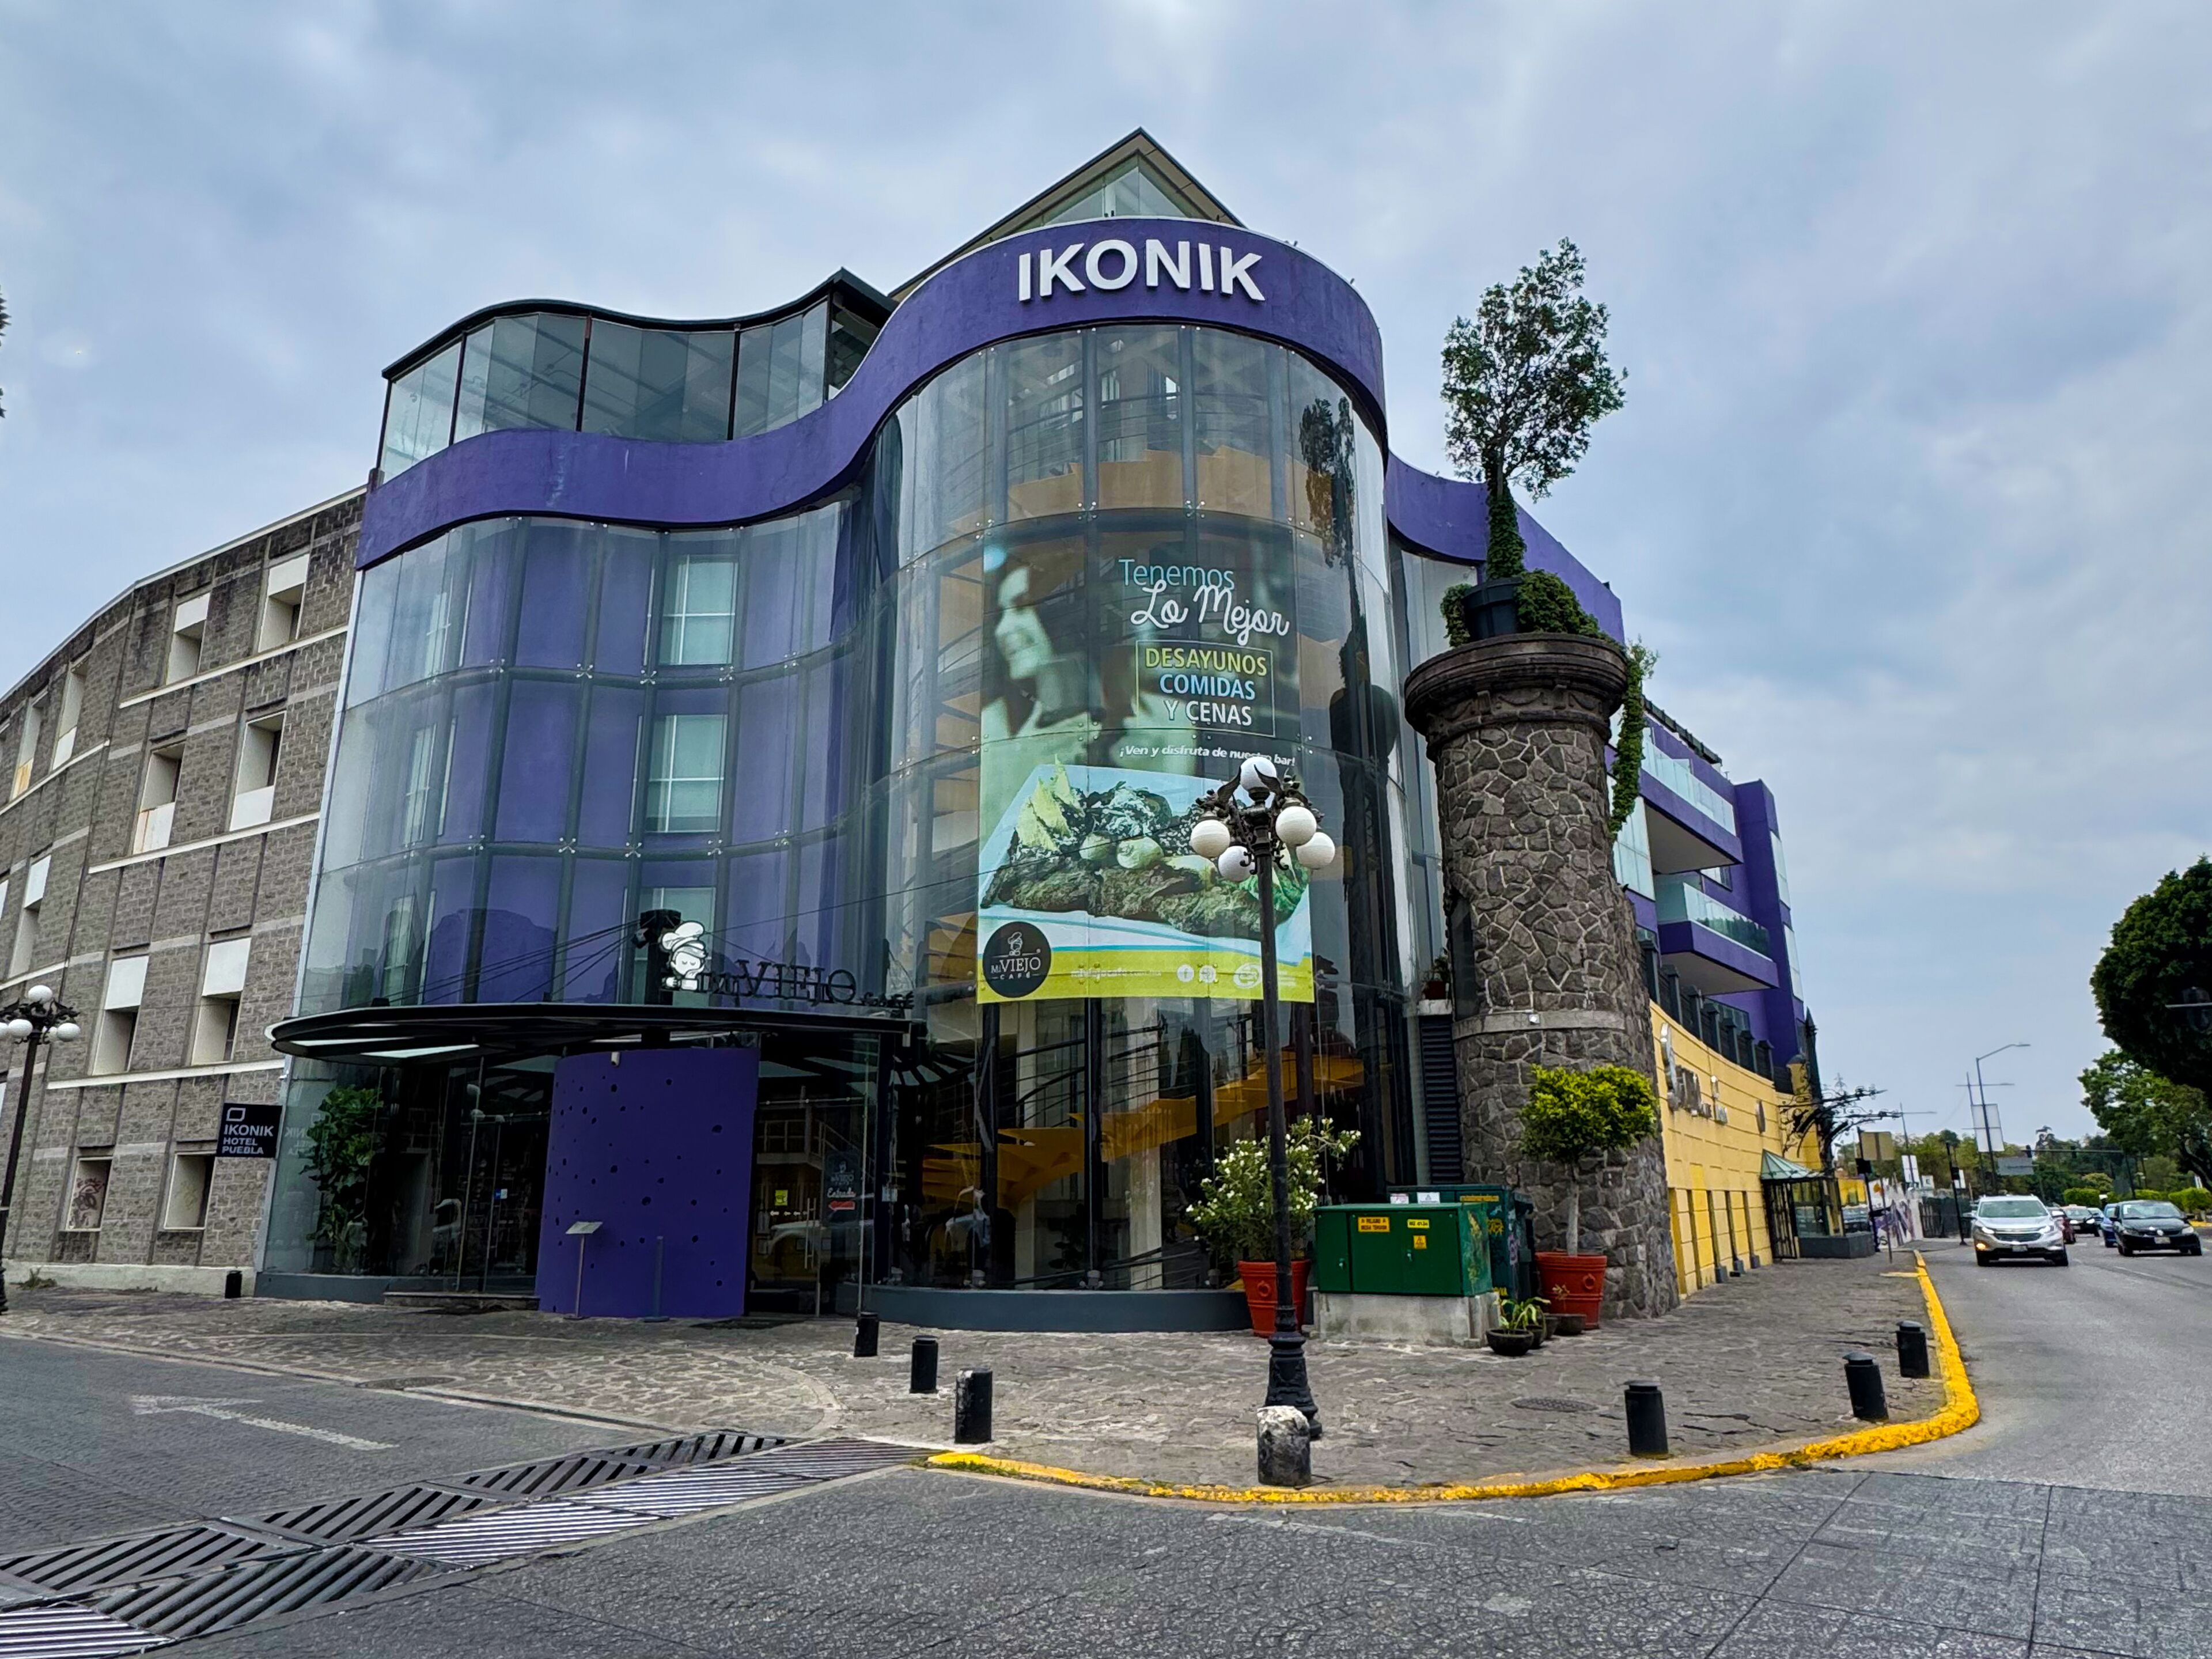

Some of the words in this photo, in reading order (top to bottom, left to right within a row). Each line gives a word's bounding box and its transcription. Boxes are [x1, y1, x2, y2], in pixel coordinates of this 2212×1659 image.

[1018, 239, 1266, 302] IKONIK
[1118, 559, 1234, 590] Tenemos
[1130, 579, 1188, 628] Lo
[1193, 585, 1290, 645] Mejor
[1145, 648, 1267, 676] DESAYUNOS
[1160, 674, 1255, 700] COMIDAS
[1163, 700, 1178, 720] Y
[1185, 700, 1252, 726] CENAS
[1150, 747, 1159, 757] y
[1161, 745, 1210, 757] disfruta
[1212, 747, 1228, 757] de
[1274, 753, 1296, 767] bar!
[999, 957, 1041, 972] VIEJO
[223, 1137, 258, 1145] HOTEL
[224, 1124, 274, 1137] IKONIK
[222, 1146, 264, 1154] PUEBLA
